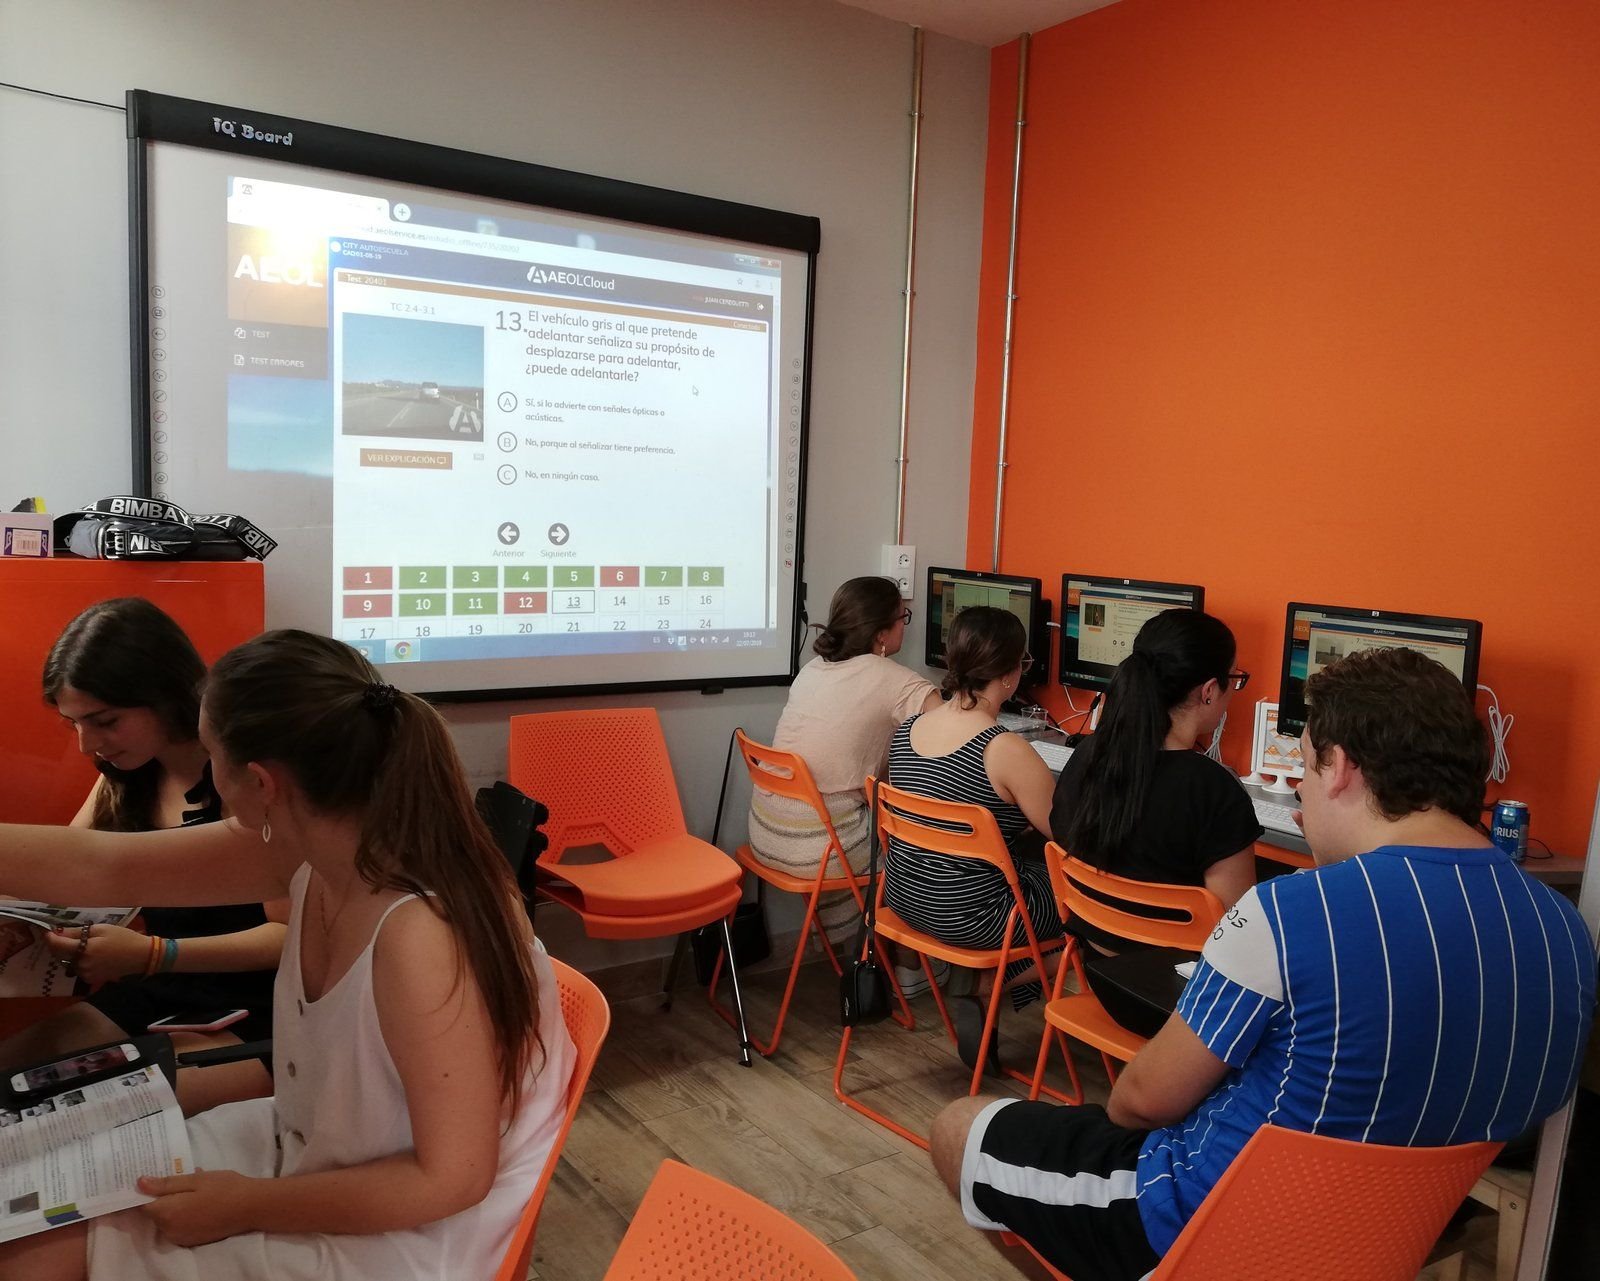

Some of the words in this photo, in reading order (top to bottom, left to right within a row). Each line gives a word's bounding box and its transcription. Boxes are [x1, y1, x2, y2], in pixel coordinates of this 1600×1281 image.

[241, 124, 293, 146] Board
[342, 241, 359, 250] CITY
[360, 243, 409, 256] AUTOESCUELA
[233, 254, 324, 288] AEOL
[547, 270, 615, 290] AEOLCloud
[390, 302, 402, 312] TC
[404, 303, 435, 315] 2.4-3.1
[528, 310, 539, 322] El
[541, 313, 589, 327] vehículo
[592, 318, 613, 331] gris
[615, 320, 626, 332] al
[628, 324, 649, 336] que
[651, 325, 698, 340] pretende
[251, 329, 271, 339] TEST
[528, 328, 585, 344] adelantar
[587, 335, 633, 349] señaliza
[635, 341, 648, 350] su
[651, 342, 700, 356] propósito
[702, 347, 715, 358] de
[249, 356, 269, 366] TEST
[526, 344, 596, 361] desplazarse
[598, 353, 624, 365] para
[627, 355, 681, 371] adelantar,
[525, 363, 568, 376] ¿puede
[570, 366, 640, 382] adelantarle?
[525, 398, 535, 408] Sí,
[536, 399, 544, 408] si
[545, 399, 553, 408] lo
[554, 401, 587, 411] advierte
[587, 404, 602, 412] con
[603, 404, 631, 414] señales
[632, 406, 659, 417] ópticas
[525, 411, 564, 423] acústicas.
[525, 438, 539, 448] No,
[540, 439, 568, 450] porque
[569, 440, 577, 449] al
[578, 440, 612, 451] señalizar
[614, 443, 632, 452] tiene
[633, 444, 676, 456] preferencia.
[367, 453, 384, 463] VER
[384, 454, 436, 464] EXPLICACIÓN
[525, 470, 539, 480] No,
[552, 471, 578, 482] ningún
[580, 473, 600, 482] caso.
[492, 548, 525, 558] Anterior
[540, 548, 577, 560] Siguiente
[364, 572, 372, 584] 1
[419, 571, 427, 583] 2
[471, 571, 480, 582] 3
[522, 571, 530, 582] 4
[570, 571, 578, 581] 5
[616, 571, 624, 581] 6
[660, 571, 668, 581] 7
[702, 571, 710, 581] 8
[363, 600, 372, 612] 9
[415, 599, 431, 610] 10
[468, 598, 483, 609] 11
[519, 597, 533, 608] 12
[567, 596, 581, 608] 13
[613, 596, 626, 606] 14
[658, 596, 670, 605] 15
[700, 595, 712, 605] 16
[360, 628, 375, 640] 17
[415, 626, 431, 637] 18
[468, 624, 483, 635] 19
[518, 623, 533, 634] 20
[567, 622, 580, 632] 21
[613, 620, 626, 631] 22
[657, 619, 670, 629] 23
[699, 619, 712, 629] 24
